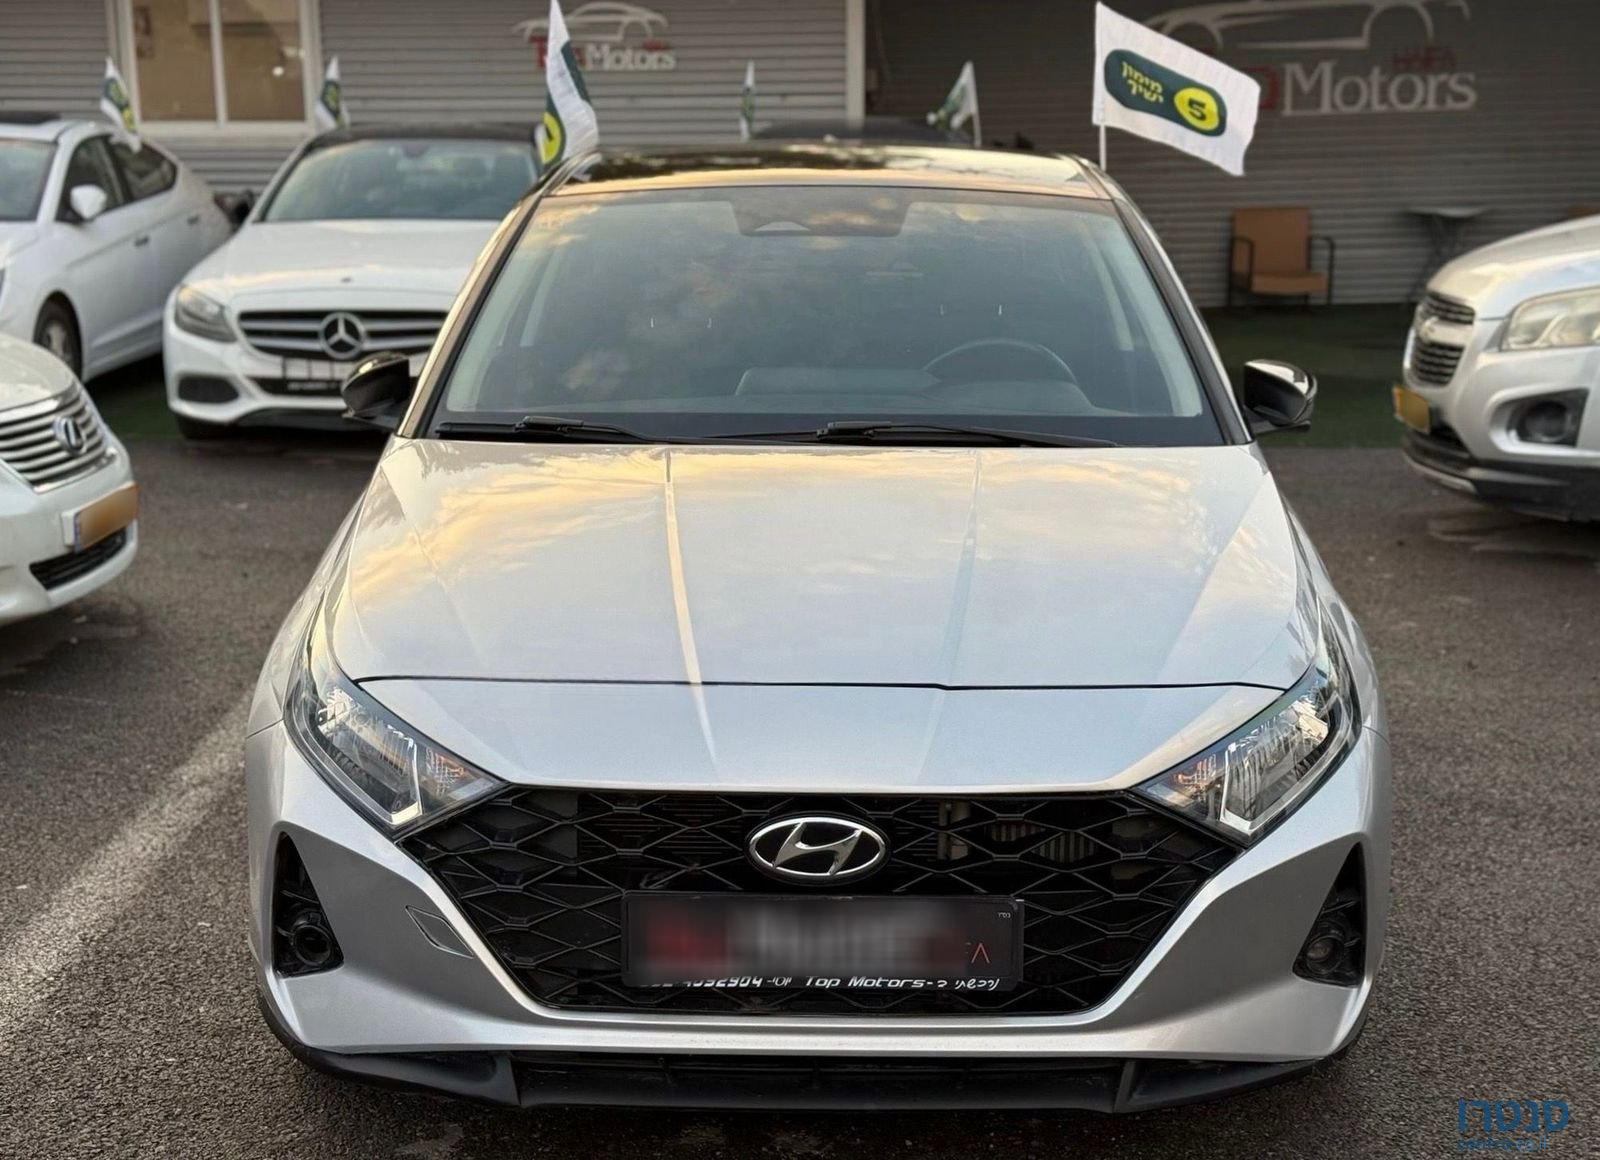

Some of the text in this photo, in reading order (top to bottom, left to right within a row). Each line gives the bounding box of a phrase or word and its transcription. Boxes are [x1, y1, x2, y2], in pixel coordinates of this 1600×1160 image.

[586, 43, 677, 70] Motors
[1121, 61, 1163, 93] מימון
[1281, 60, 1477, 116] Motors
[1127, 79, 1164, 103] ישיר
[1187, 98, 1206, 121] 5
[805, 976, 841, 989] Top
